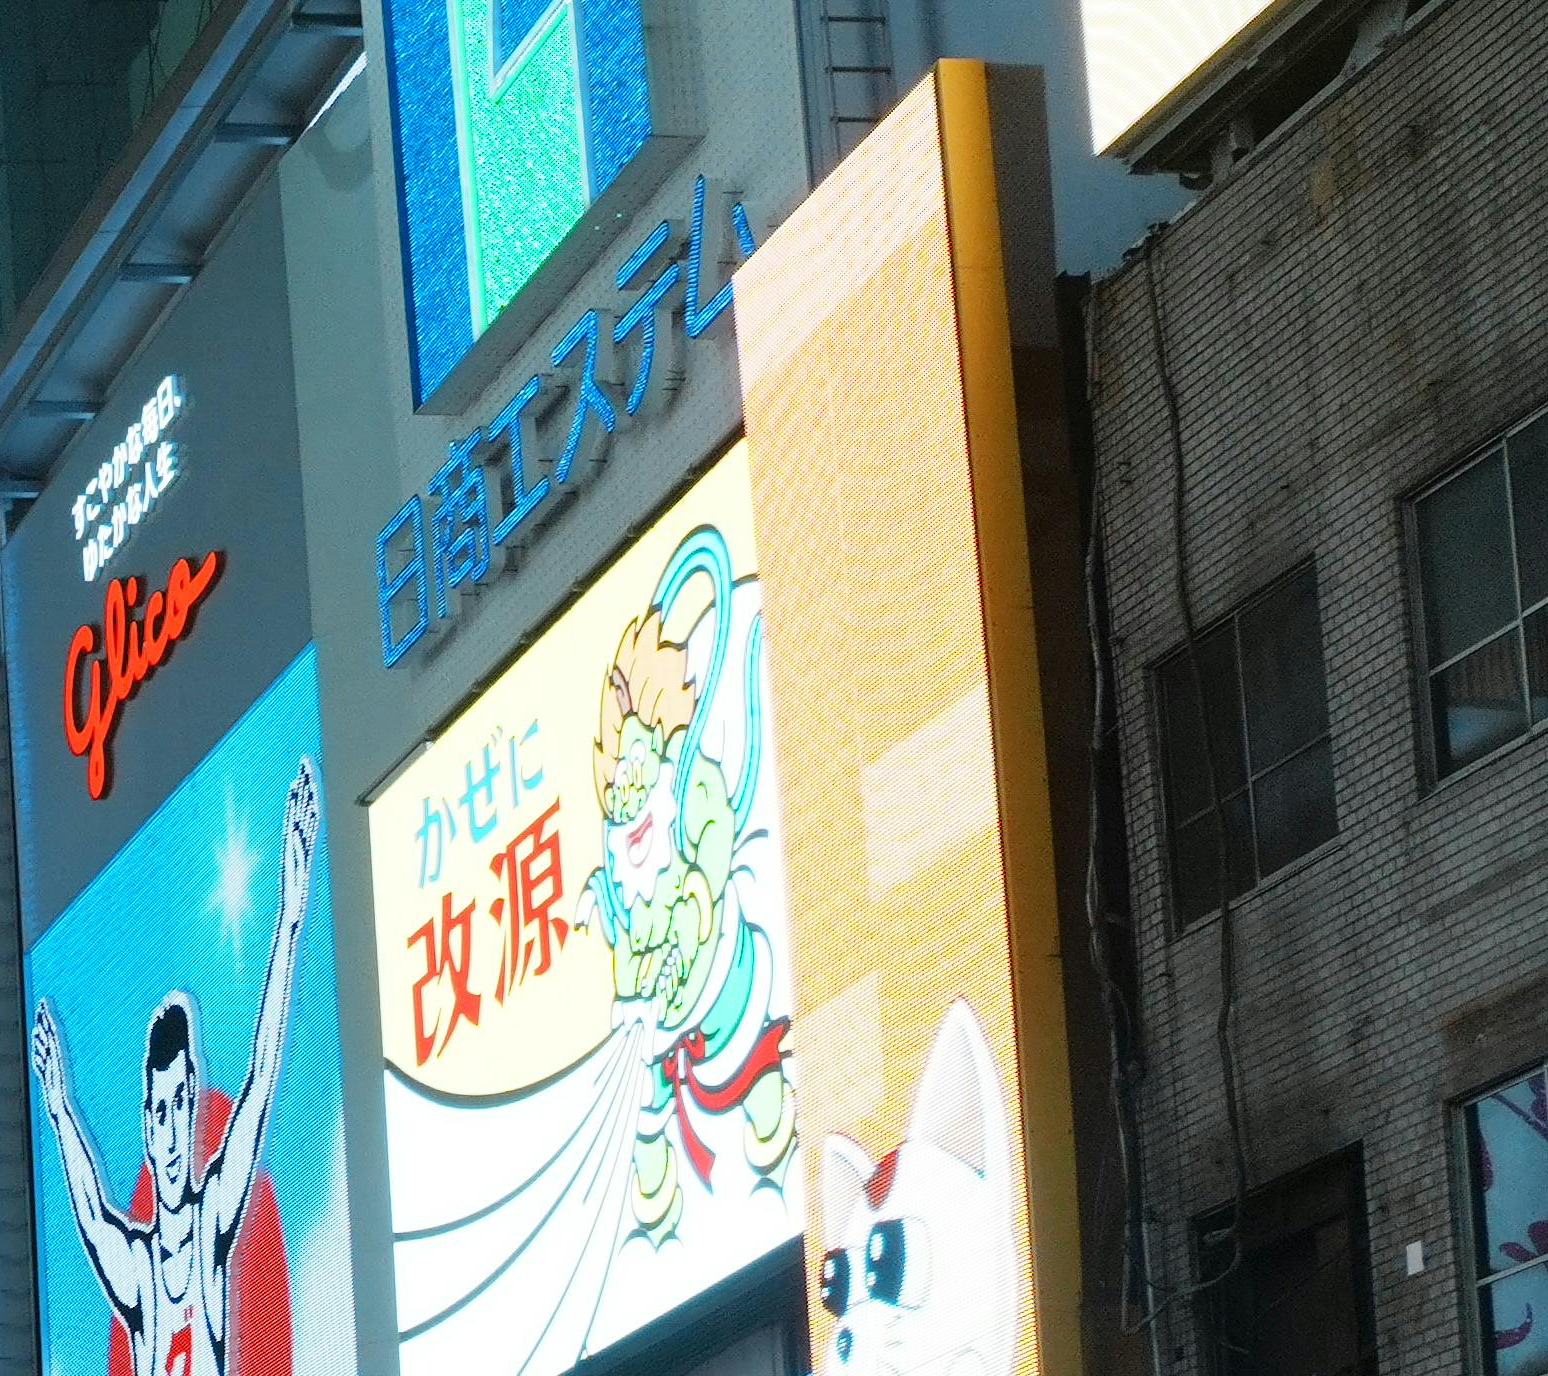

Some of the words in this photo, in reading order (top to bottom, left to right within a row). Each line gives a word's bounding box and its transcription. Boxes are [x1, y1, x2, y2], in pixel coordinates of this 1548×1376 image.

[81, 440, 179, 583] ゆたかな人生
[62, 550, 217, 801] Glico
[416, 715, 545, 890] かぜに
[406, 795, 570, 1069] 改源
